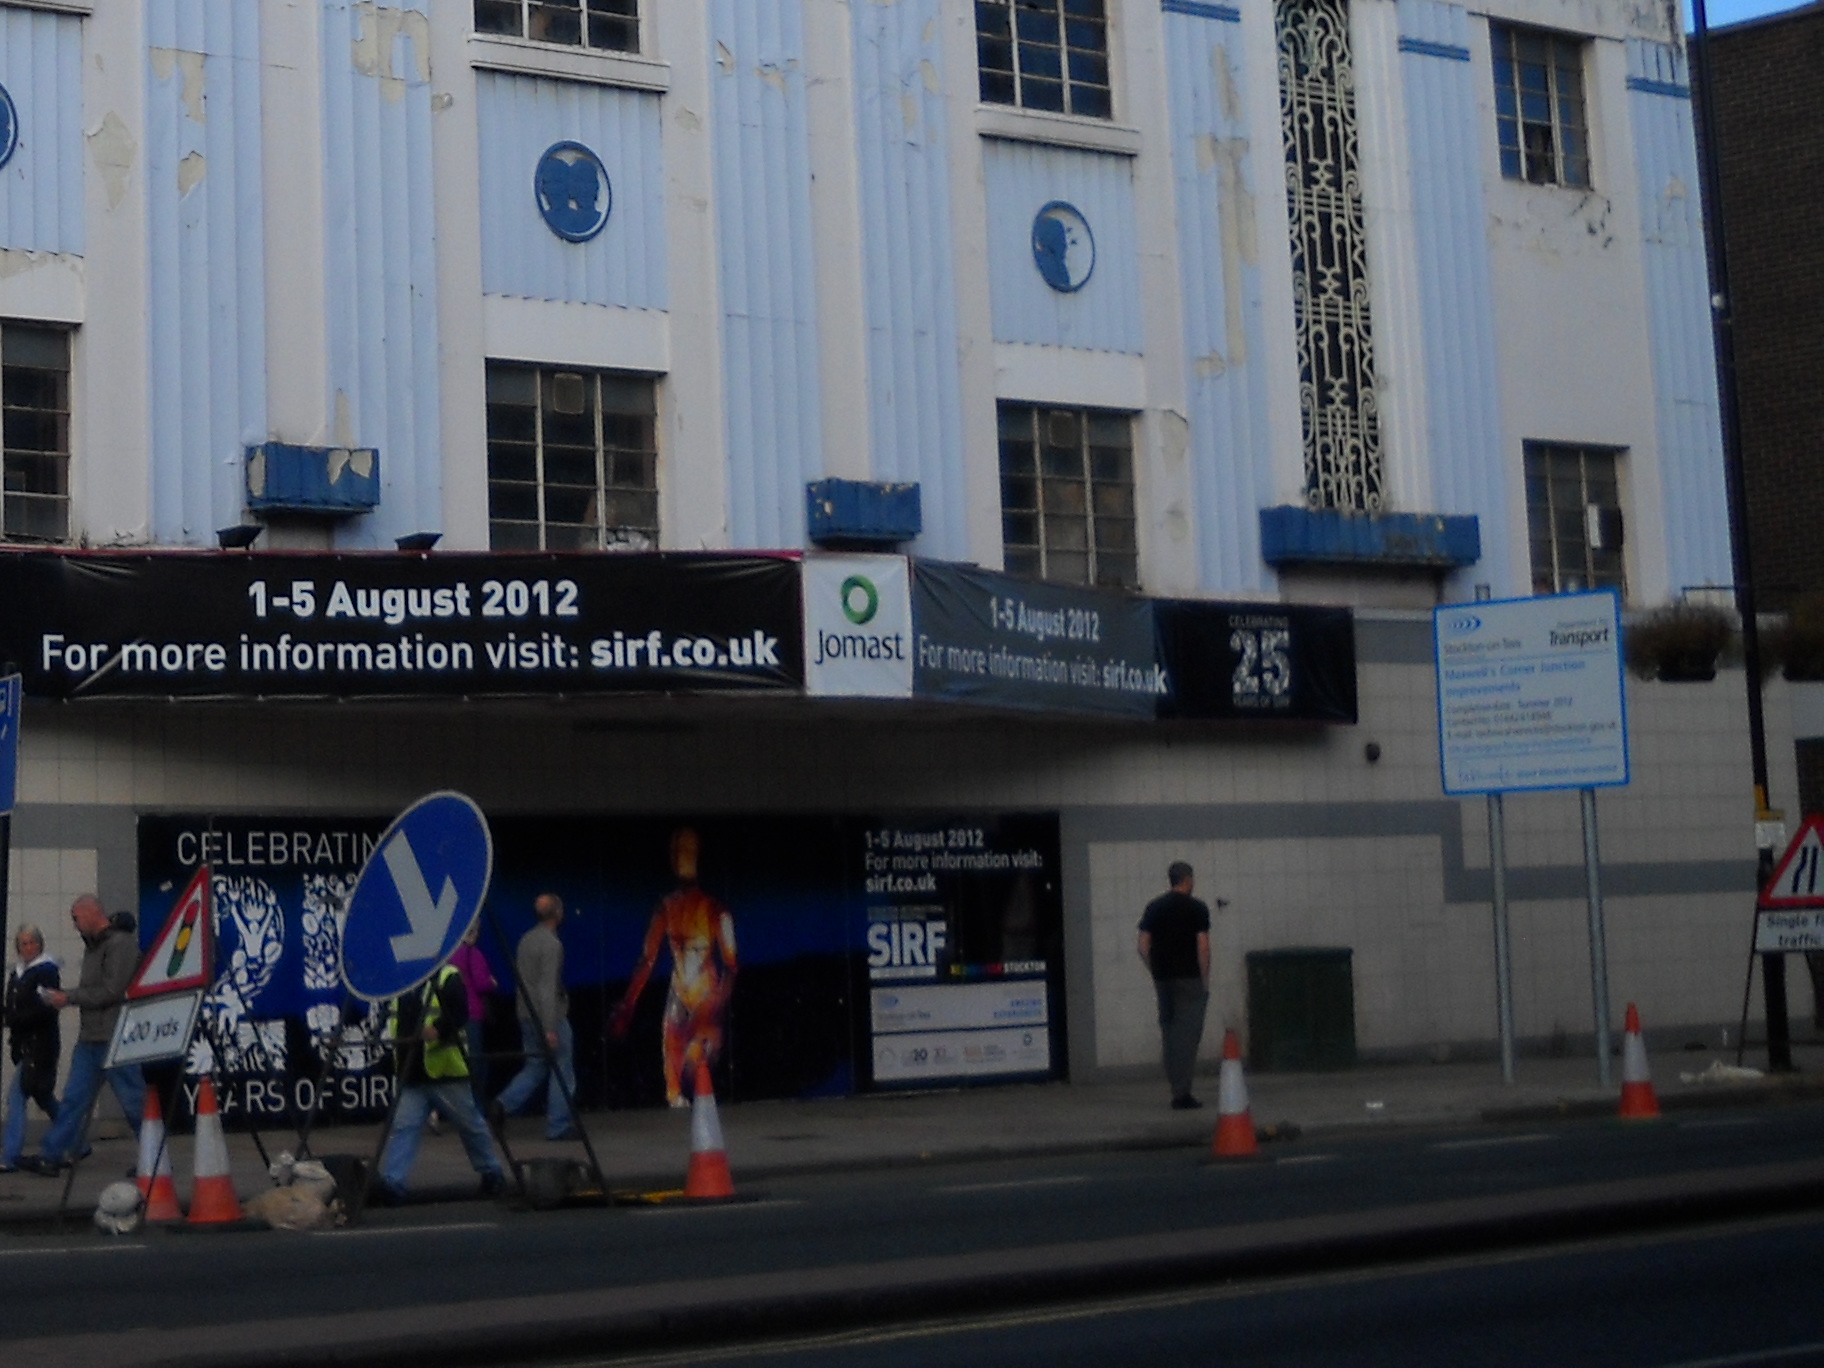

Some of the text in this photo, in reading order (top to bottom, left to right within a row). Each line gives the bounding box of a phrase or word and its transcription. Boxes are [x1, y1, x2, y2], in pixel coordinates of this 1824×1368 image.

[248, 579, 580, 624] 1-5 August 2012
[990, 596, 1100, 643] 1-5 August 2012
[42, 630, 780, 672] For more information visit: sirf.co.uk
[815, 628, 906, 665] Jomast
[1549, 628, 1608, 647] Transport
[919, 635, 944, 670] For
[947, 647, 986, 675] more
[989, 644, 1067, 683] information
[1103, 658, 1169, 694] sirf.co.uk
[1230, 629, 1291, 695] 25
[177, 830, 384, 865] CELEBRATIN
[865, 829, 984, 853] 1-5 August 2012
[865, 851, 889, 871] For
[892, 855, 929, 870] more
[932, 851, 1009, 871] information
[865, 873, 937, 893] sirf.co.uk
[1767, 915, 1808, 929] Single
[1778, 932, 1822, 947] traffic
[867, 920, 947, 967] SIRF
[341, 1075, 397, 1109] SIR
